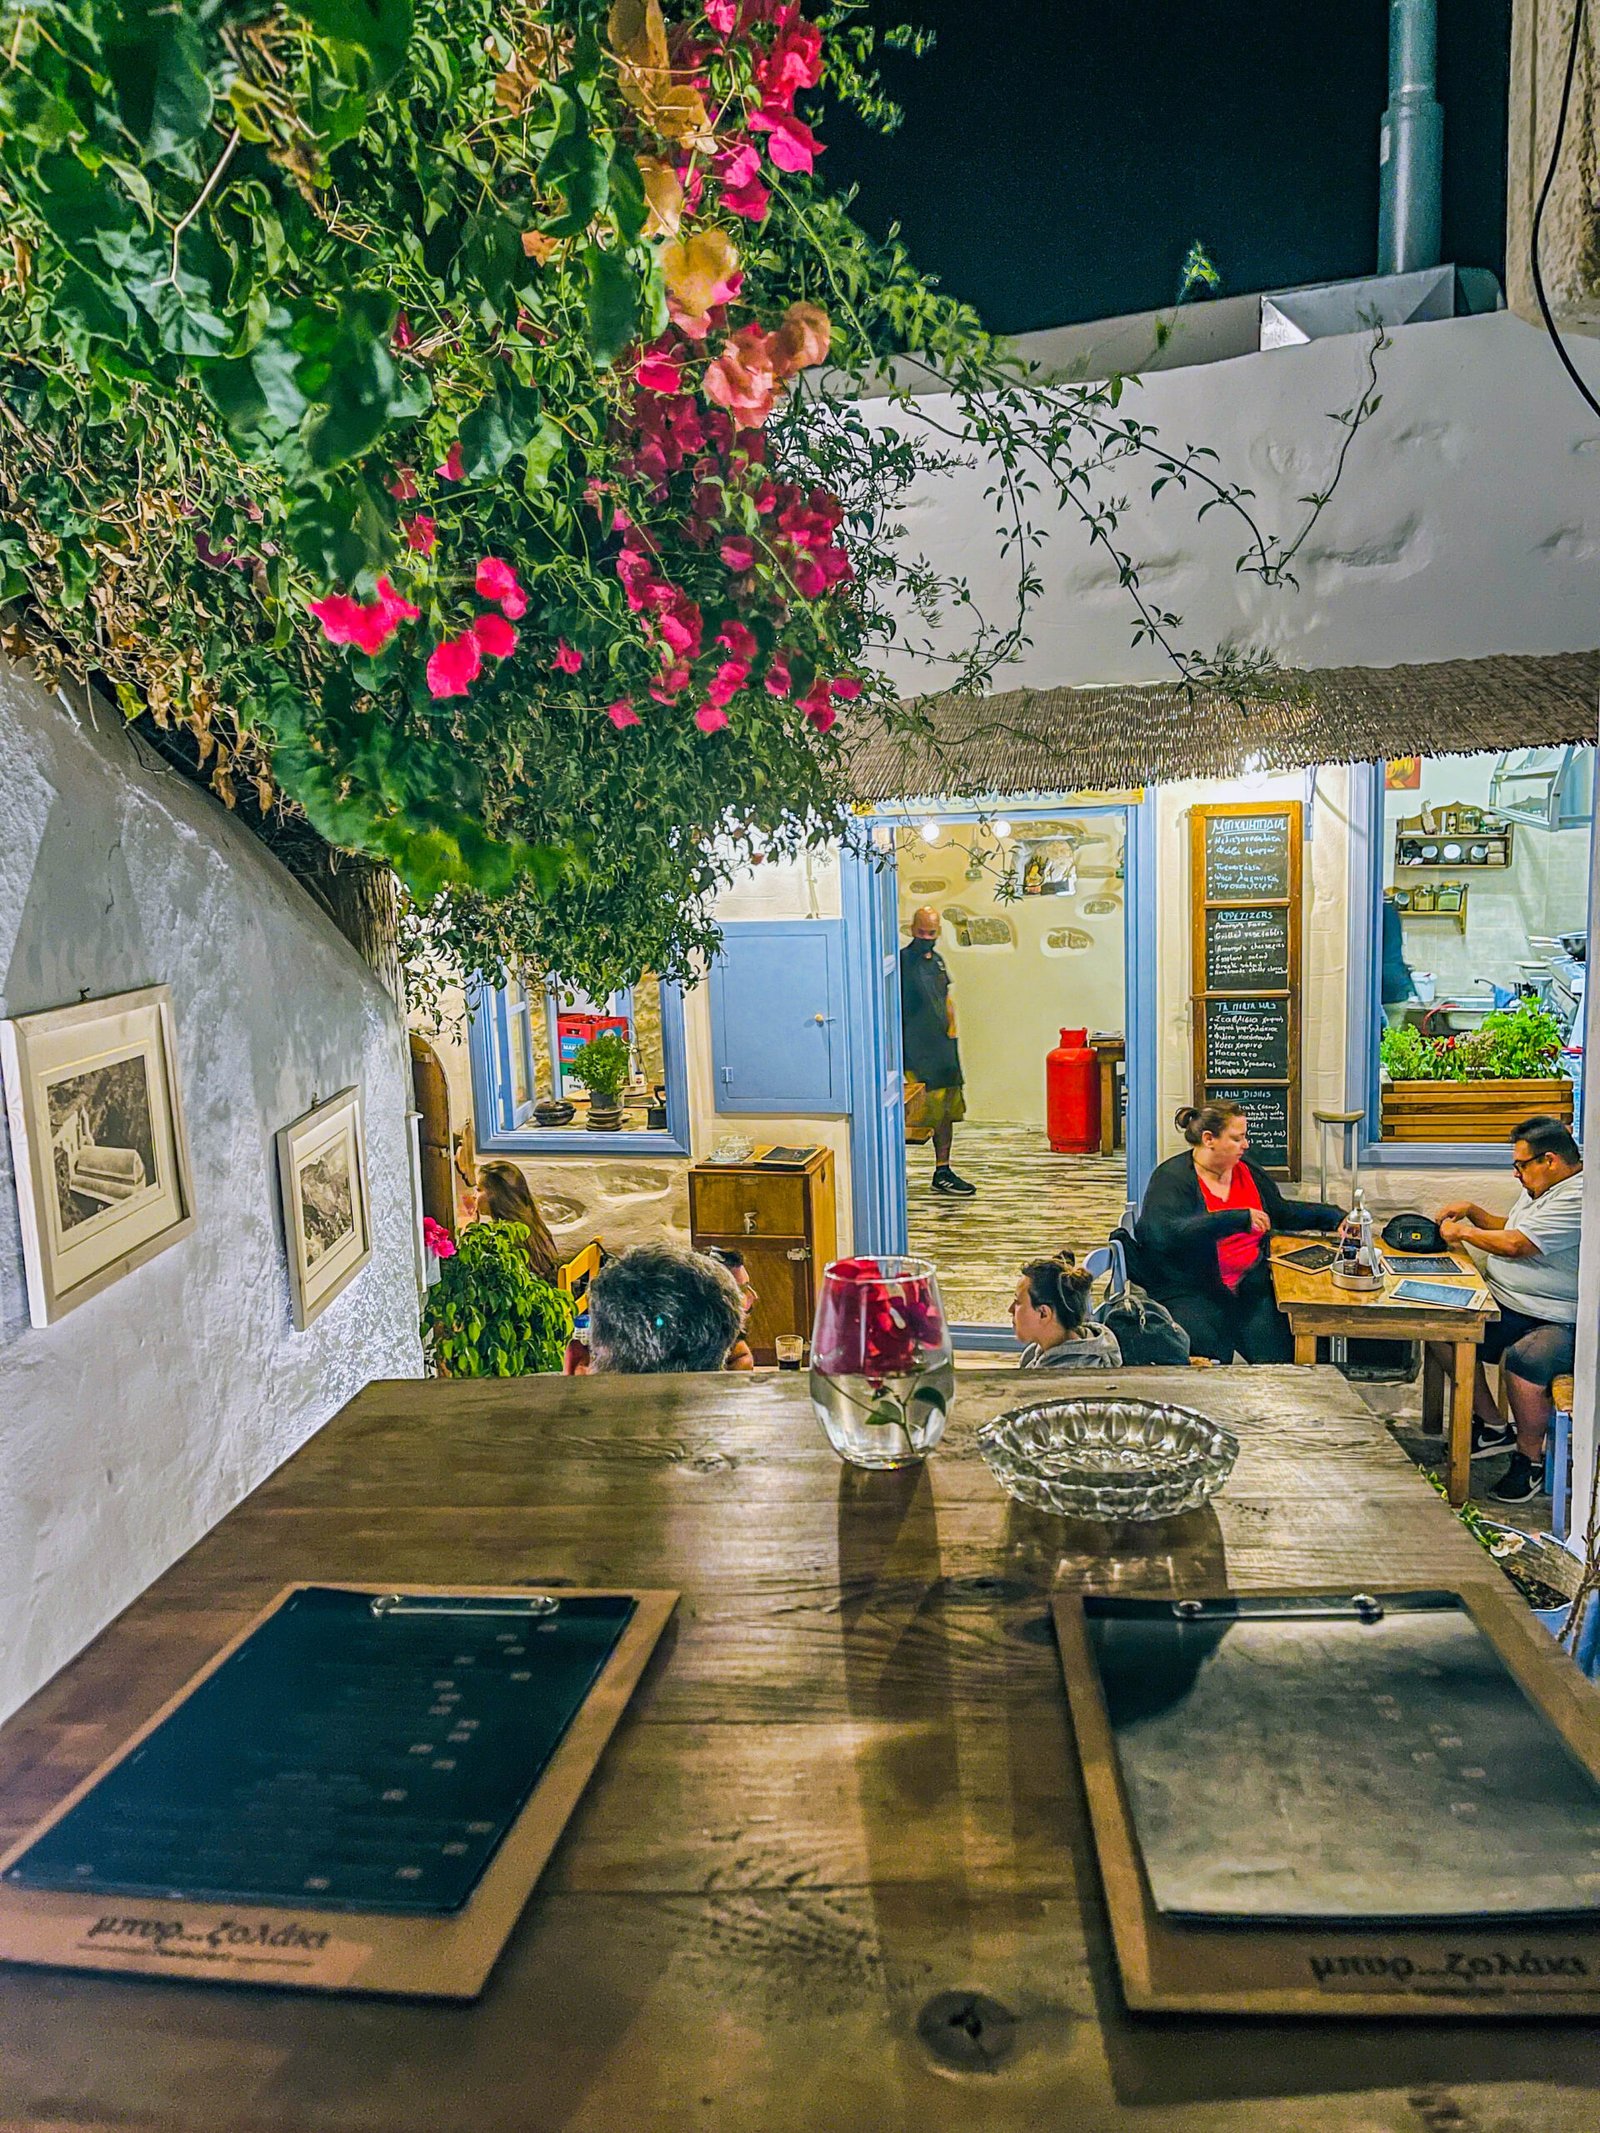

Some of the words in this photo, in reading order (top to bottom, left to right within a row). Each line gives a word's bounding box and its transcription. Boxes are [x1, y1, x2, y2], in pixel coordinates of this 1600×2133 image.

[1217, 911, 1273, 921] APPETIZERS
[1215, 930, 1241, 940] Grilled
[1244, 929, 1284, 939] vegetables
[1215, 962, 1237, 970] Greek
[1215, 1002, 1229, 1012] ΤΑ
[1232, 1002, 1256, 1010] ΠΙΑΤΑ
[1215, 1049, 1257, 1057] Πατατάτο
[1216, 1091, 1239, 1099] MAIN
[1242, 1090, 1271, 1098] DISHES
